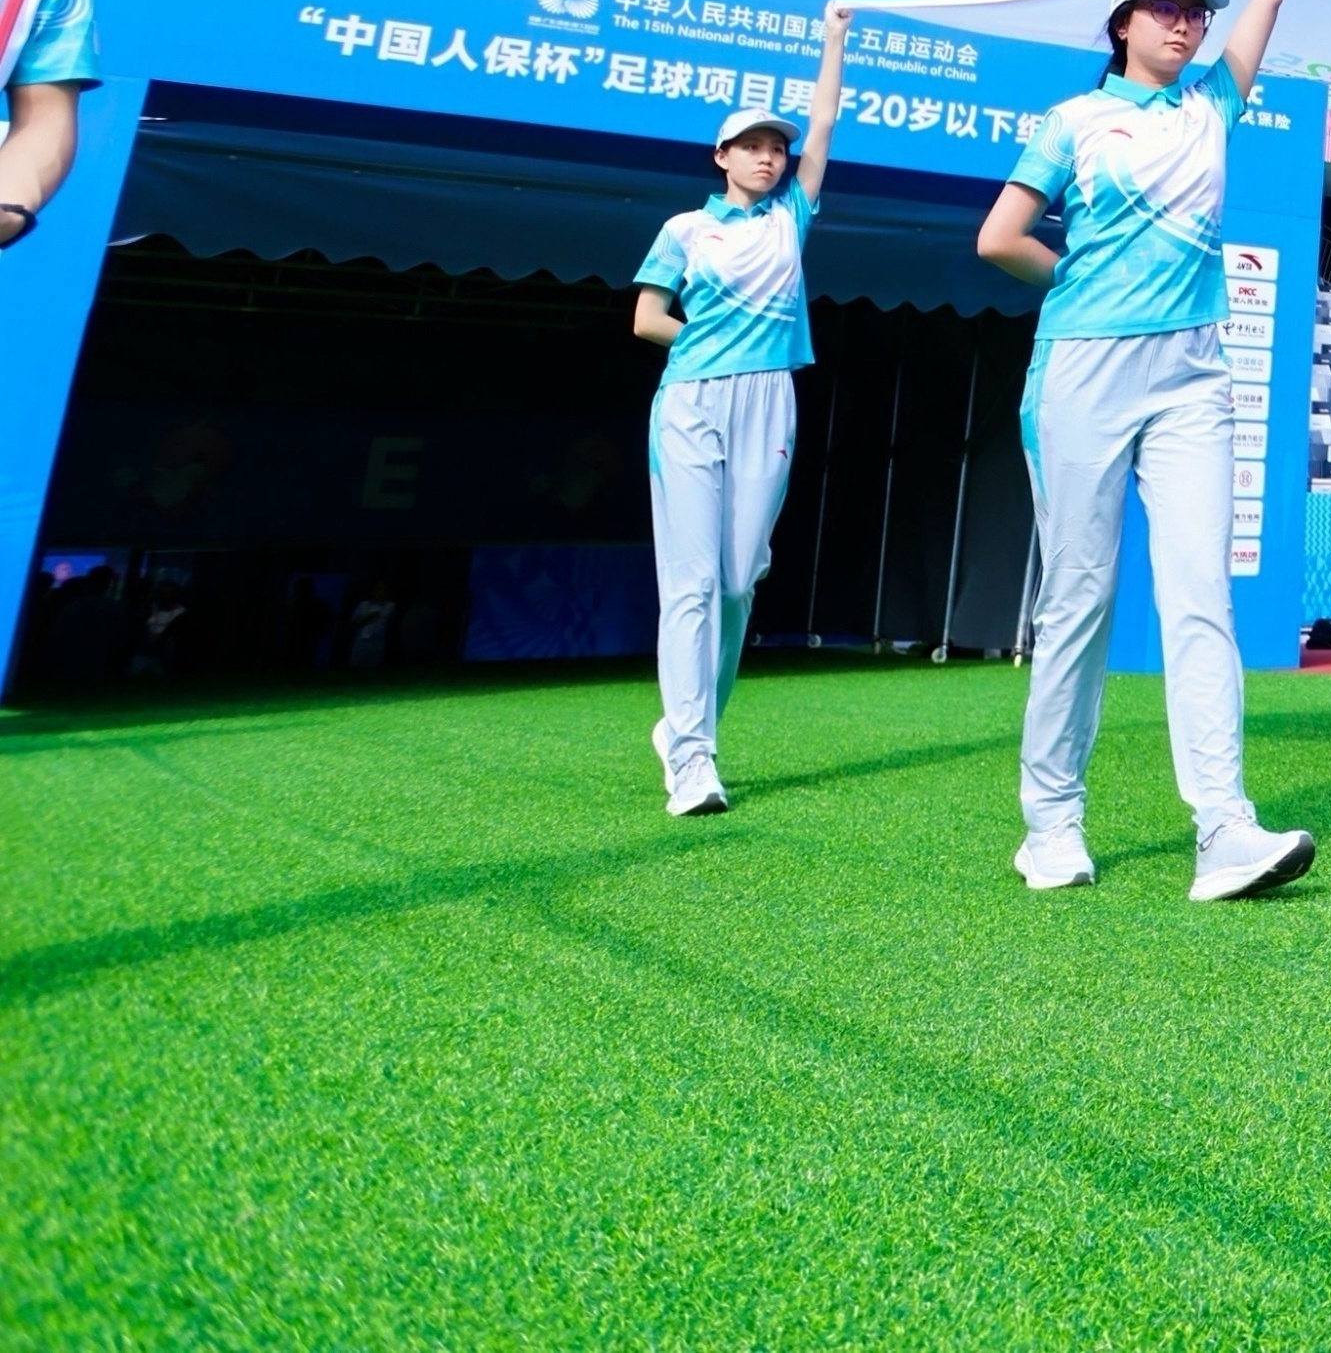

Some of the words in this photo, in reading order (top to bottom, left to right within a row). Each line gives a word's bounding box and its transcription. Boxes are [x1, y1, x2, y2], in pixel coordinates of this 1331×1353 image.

[613, 14, 639, 30] The
[644, 19, 674, 36] 15th
[677, 25, 734, 45] National
[737, 34, 782, 53] Games
[784, 40, 800, 55] of
[801, 42, 822, 58] the
[842, 52, 875, 68] ople's
[877, 56, 928, 76] Republic
[930, 65, 942, 78] of
[944, 67, 977, 84] China
[1238, 287, 1257, 297] PICC
